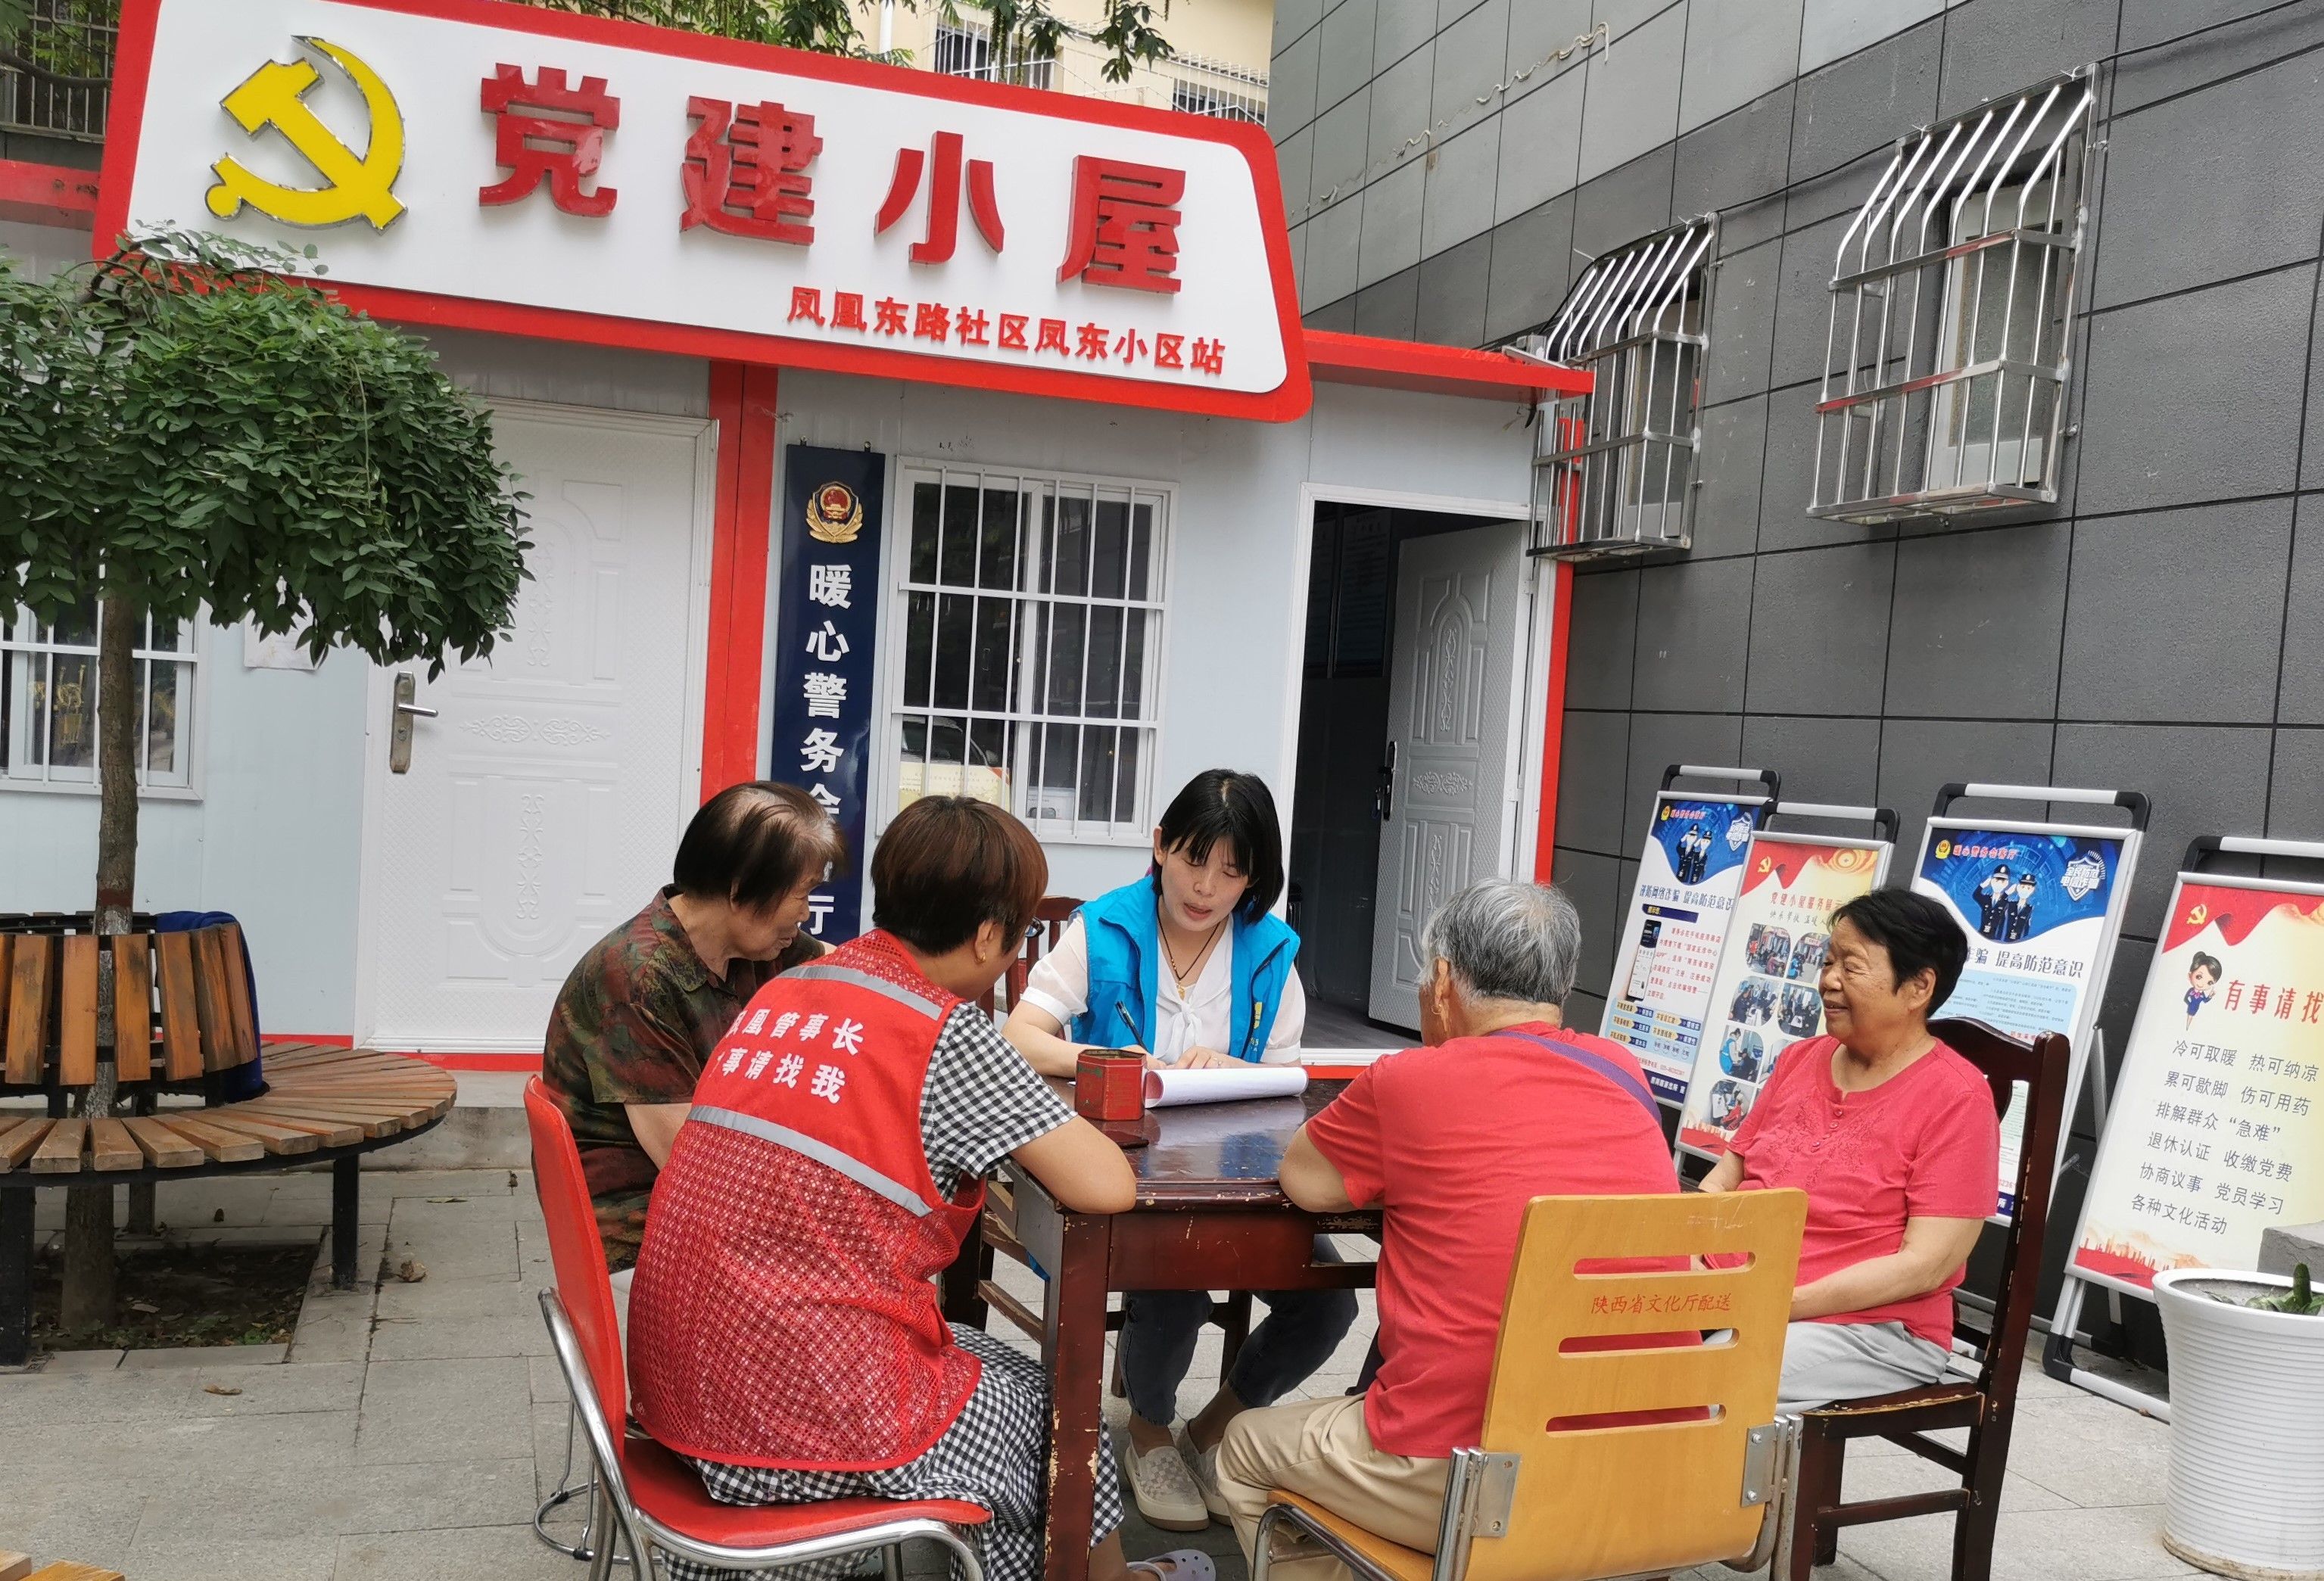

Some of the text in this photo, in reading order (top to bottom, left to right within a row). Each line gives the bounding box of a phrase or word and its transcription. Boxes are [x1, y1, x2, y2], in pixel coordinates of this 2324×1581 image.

[479, 63, 1186, 293] 党建小屋
[787, 285, 1226, 375] 凤凰东路社区凤东小区站
[798, 563, 852, 935] 暖心警务会厅
[1995, 950, 2084, 979] 提高防范意识
[2224, 979, 2324, 1024] 有事请找
[709, 1047, 846, 1103] 事请找我
[2172, 1039, 2319, 1082] 冷可取暖 热可纳凉
[2164, 1070, 2311, 1116] 累可歇脚 伤可用药
[2156, 1100, 2281, 1142] 排解群众 “急难”
[2147, 1131, 2293, 1182] 退休认证 收缴党费
[2139, 1161, 2284, 1215] 协商议事 党员学习
[2131, 1193, 2227, 1234] 各种文化活动
[1591, 1292, 1732, 1315] 陕西省文化厅配送
